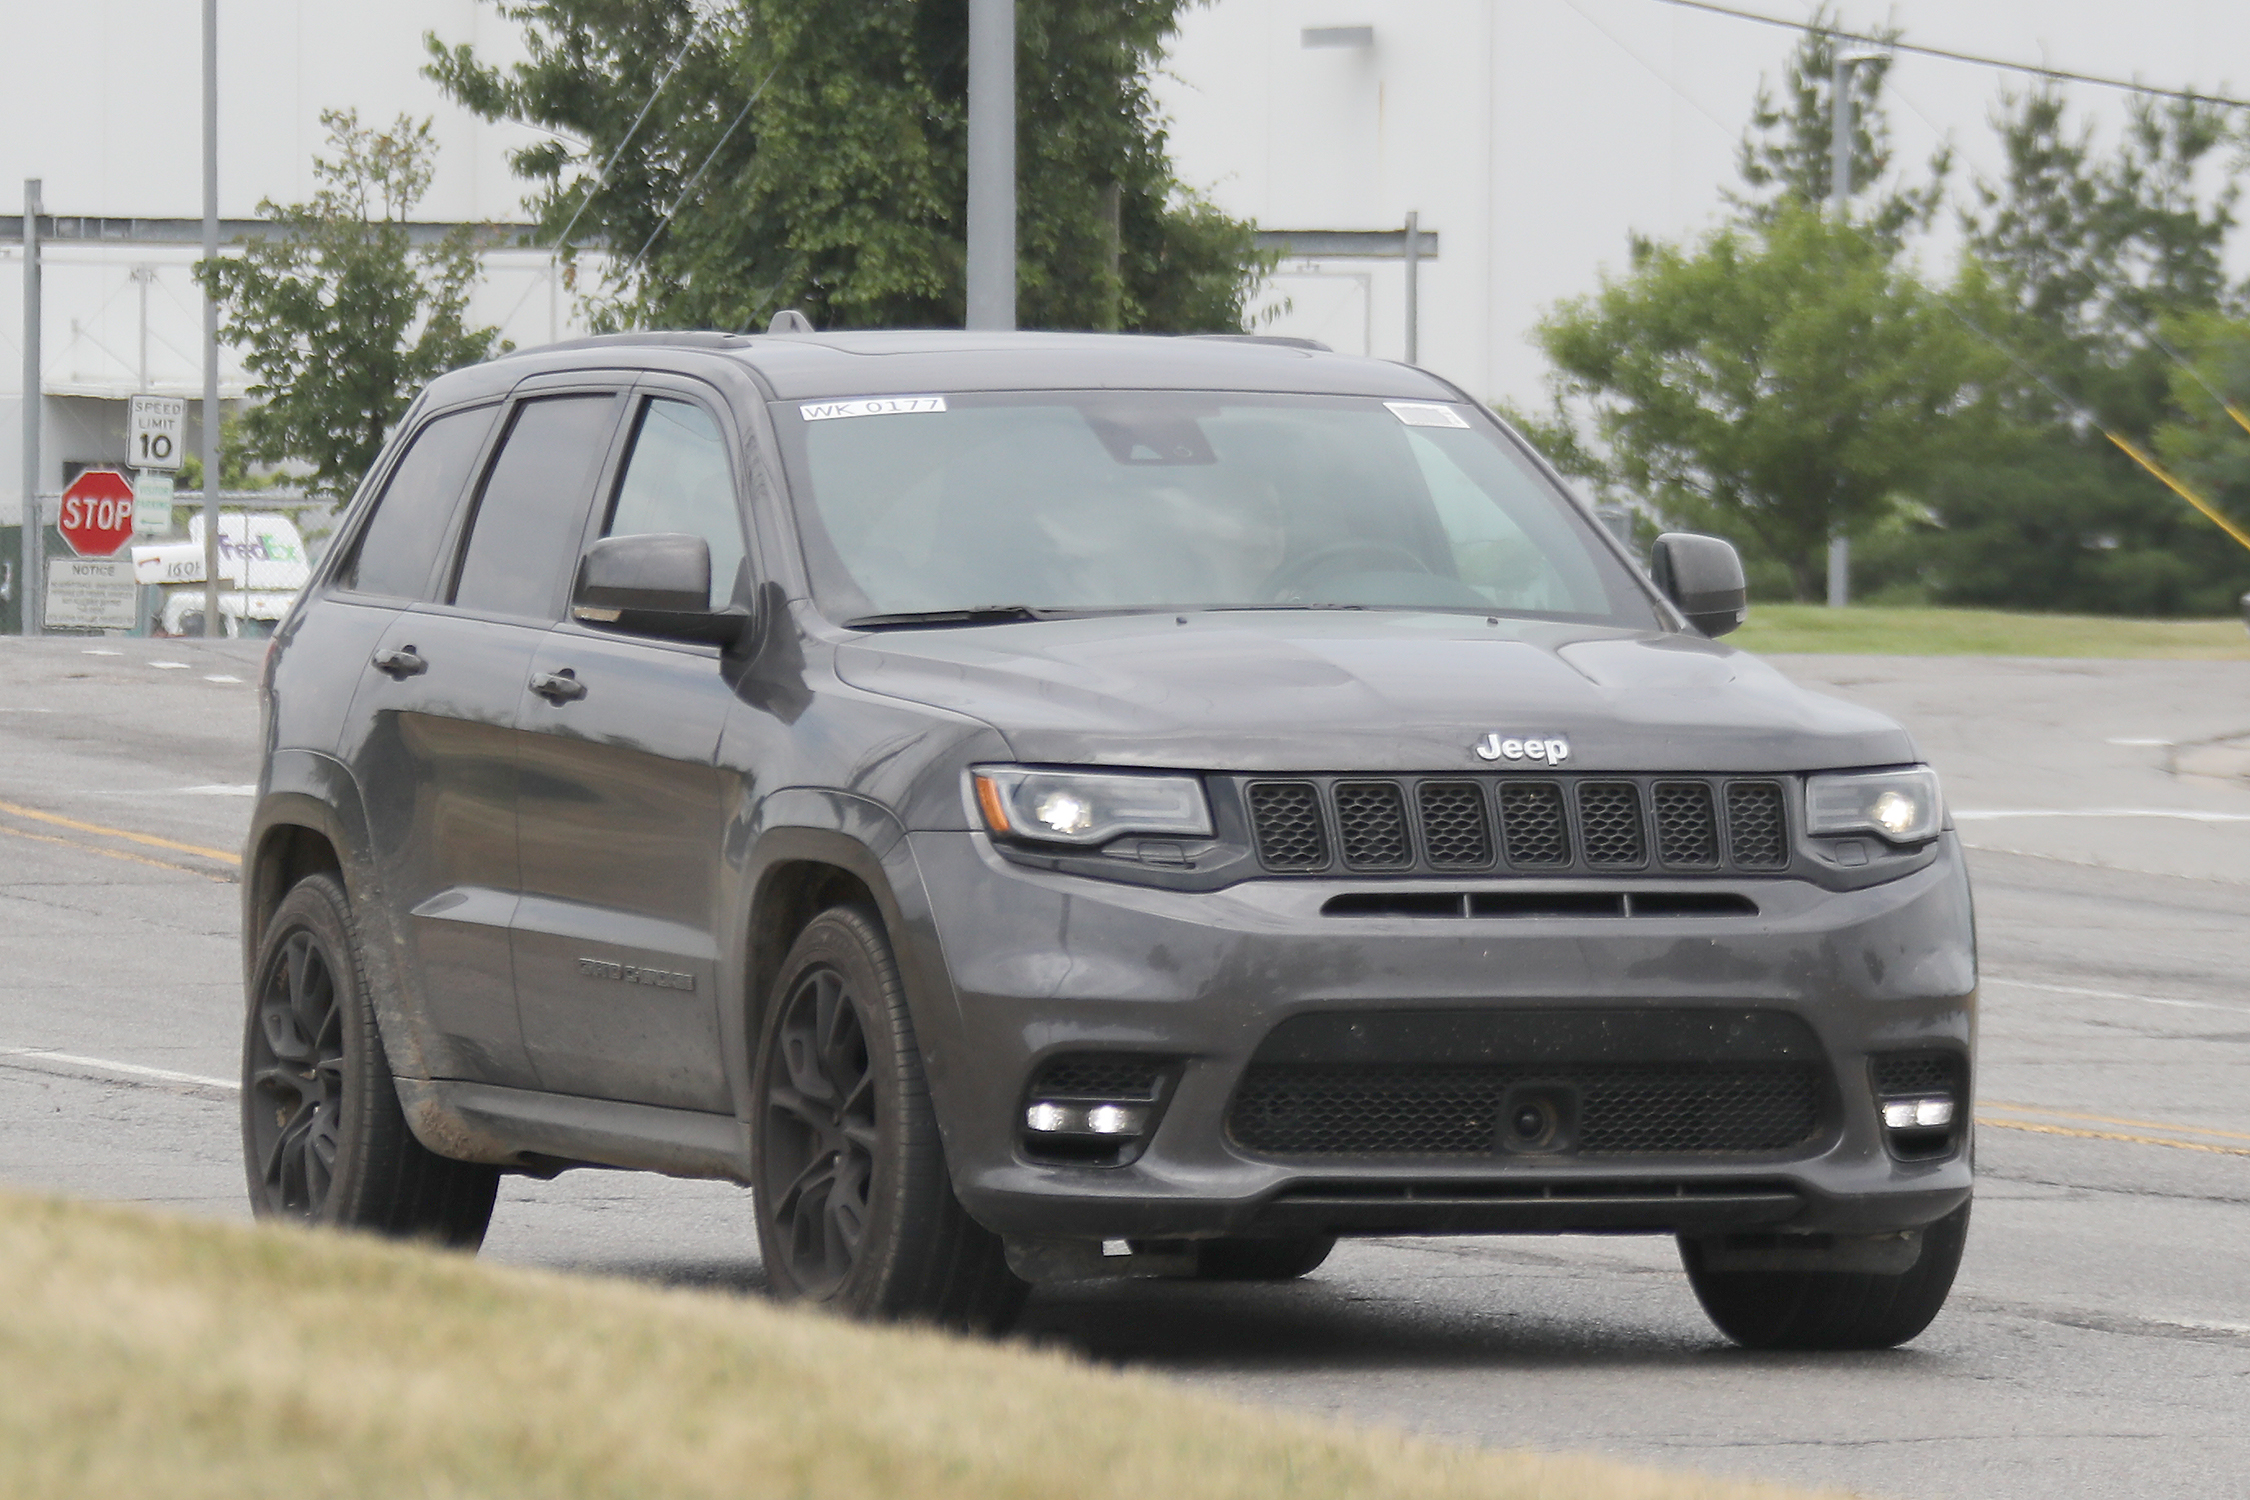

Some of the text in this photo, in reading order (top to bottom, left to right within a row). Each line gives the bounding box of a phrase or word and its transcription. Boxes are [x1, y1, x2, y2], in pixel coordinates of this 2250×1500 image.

[135, 402, 181, 415] SPEED
[804, 398, 939, 418] WK 0177
[139, 417, 175, 431] LIMIT
[139, 432, 172, 459] 10
[63, 497, 132, 531] STOP
[72, 564, 115, 577] NOTICE
[1476, 733, 1569, 766] Jeep
